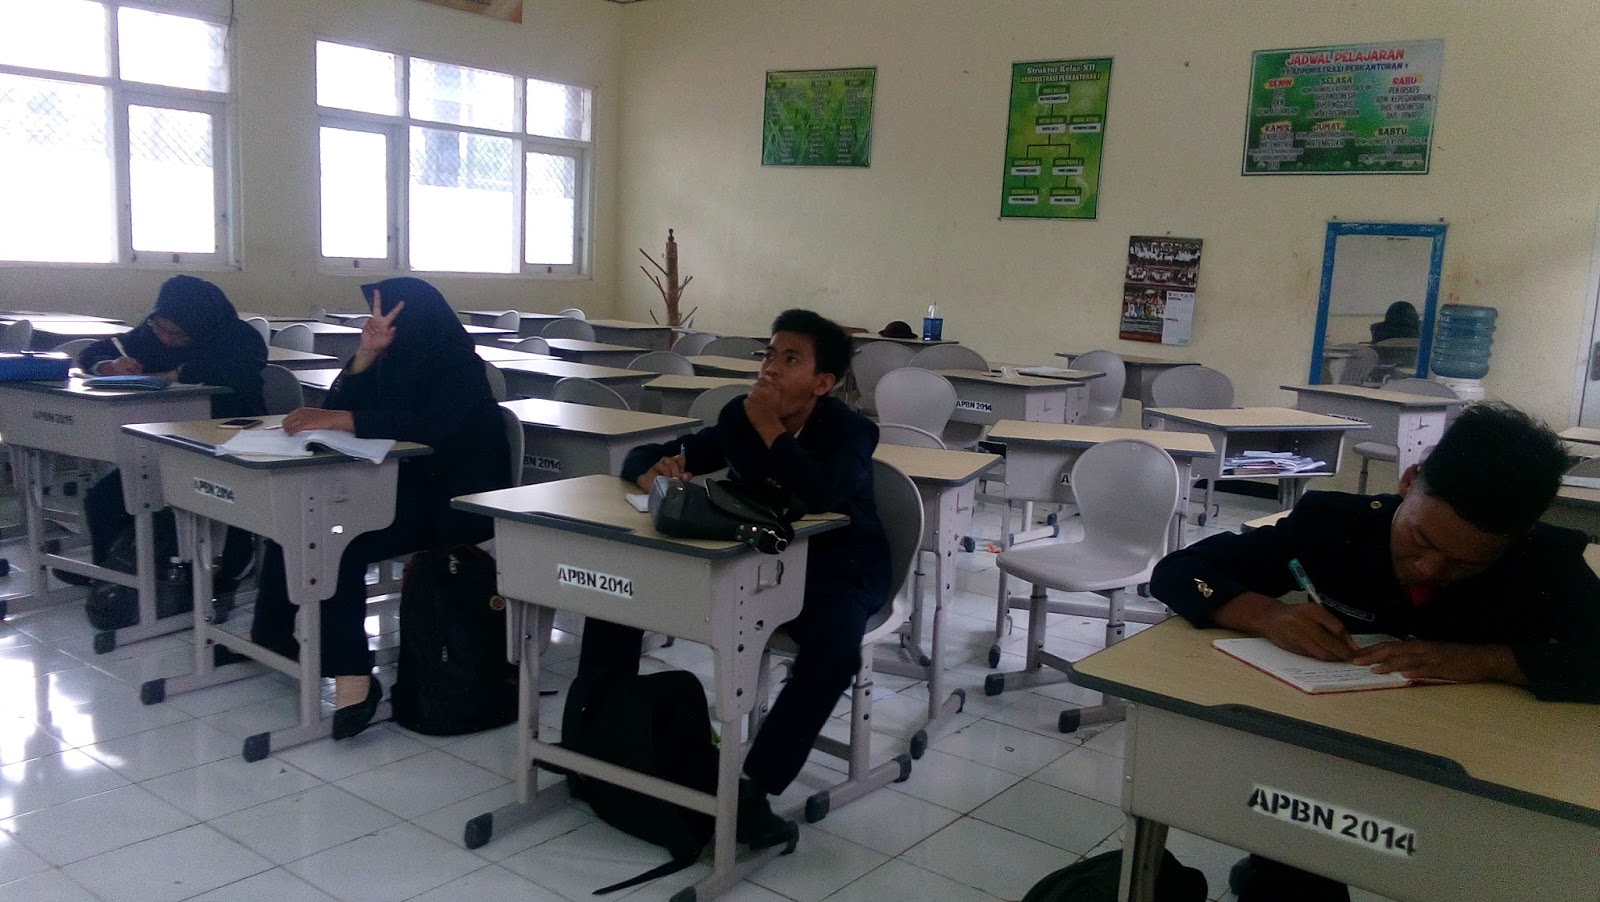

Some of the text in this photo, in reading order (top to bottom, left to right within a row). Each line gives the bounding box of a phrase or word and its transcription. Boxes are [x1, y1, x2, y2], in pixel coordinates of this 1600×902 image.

[1286, 49, 1405, 66] JADWAL PELAJARAN
[1060, 64, 1080, 73] Kelas
[1345, 62, 1403, 72] PERKANTORAN
[1268, 79, 1294, 88] SENIN
[1321, 76, 1353, 84] SELASA
[1392, 76, 1418, 85] RABU
[1265, 124, 1290, 132] KAMIS
[1314, 122, 1341, 131] JUMAT
[1378, 127, 1407, 136] SABTU
[956, 400, 992, 411] APBN 2014
[524, 456, 561, 470] BN 2014
[558, 567, 634, 596] APBN 2014
[1247, 788, 1417, 857] APBN 2014
